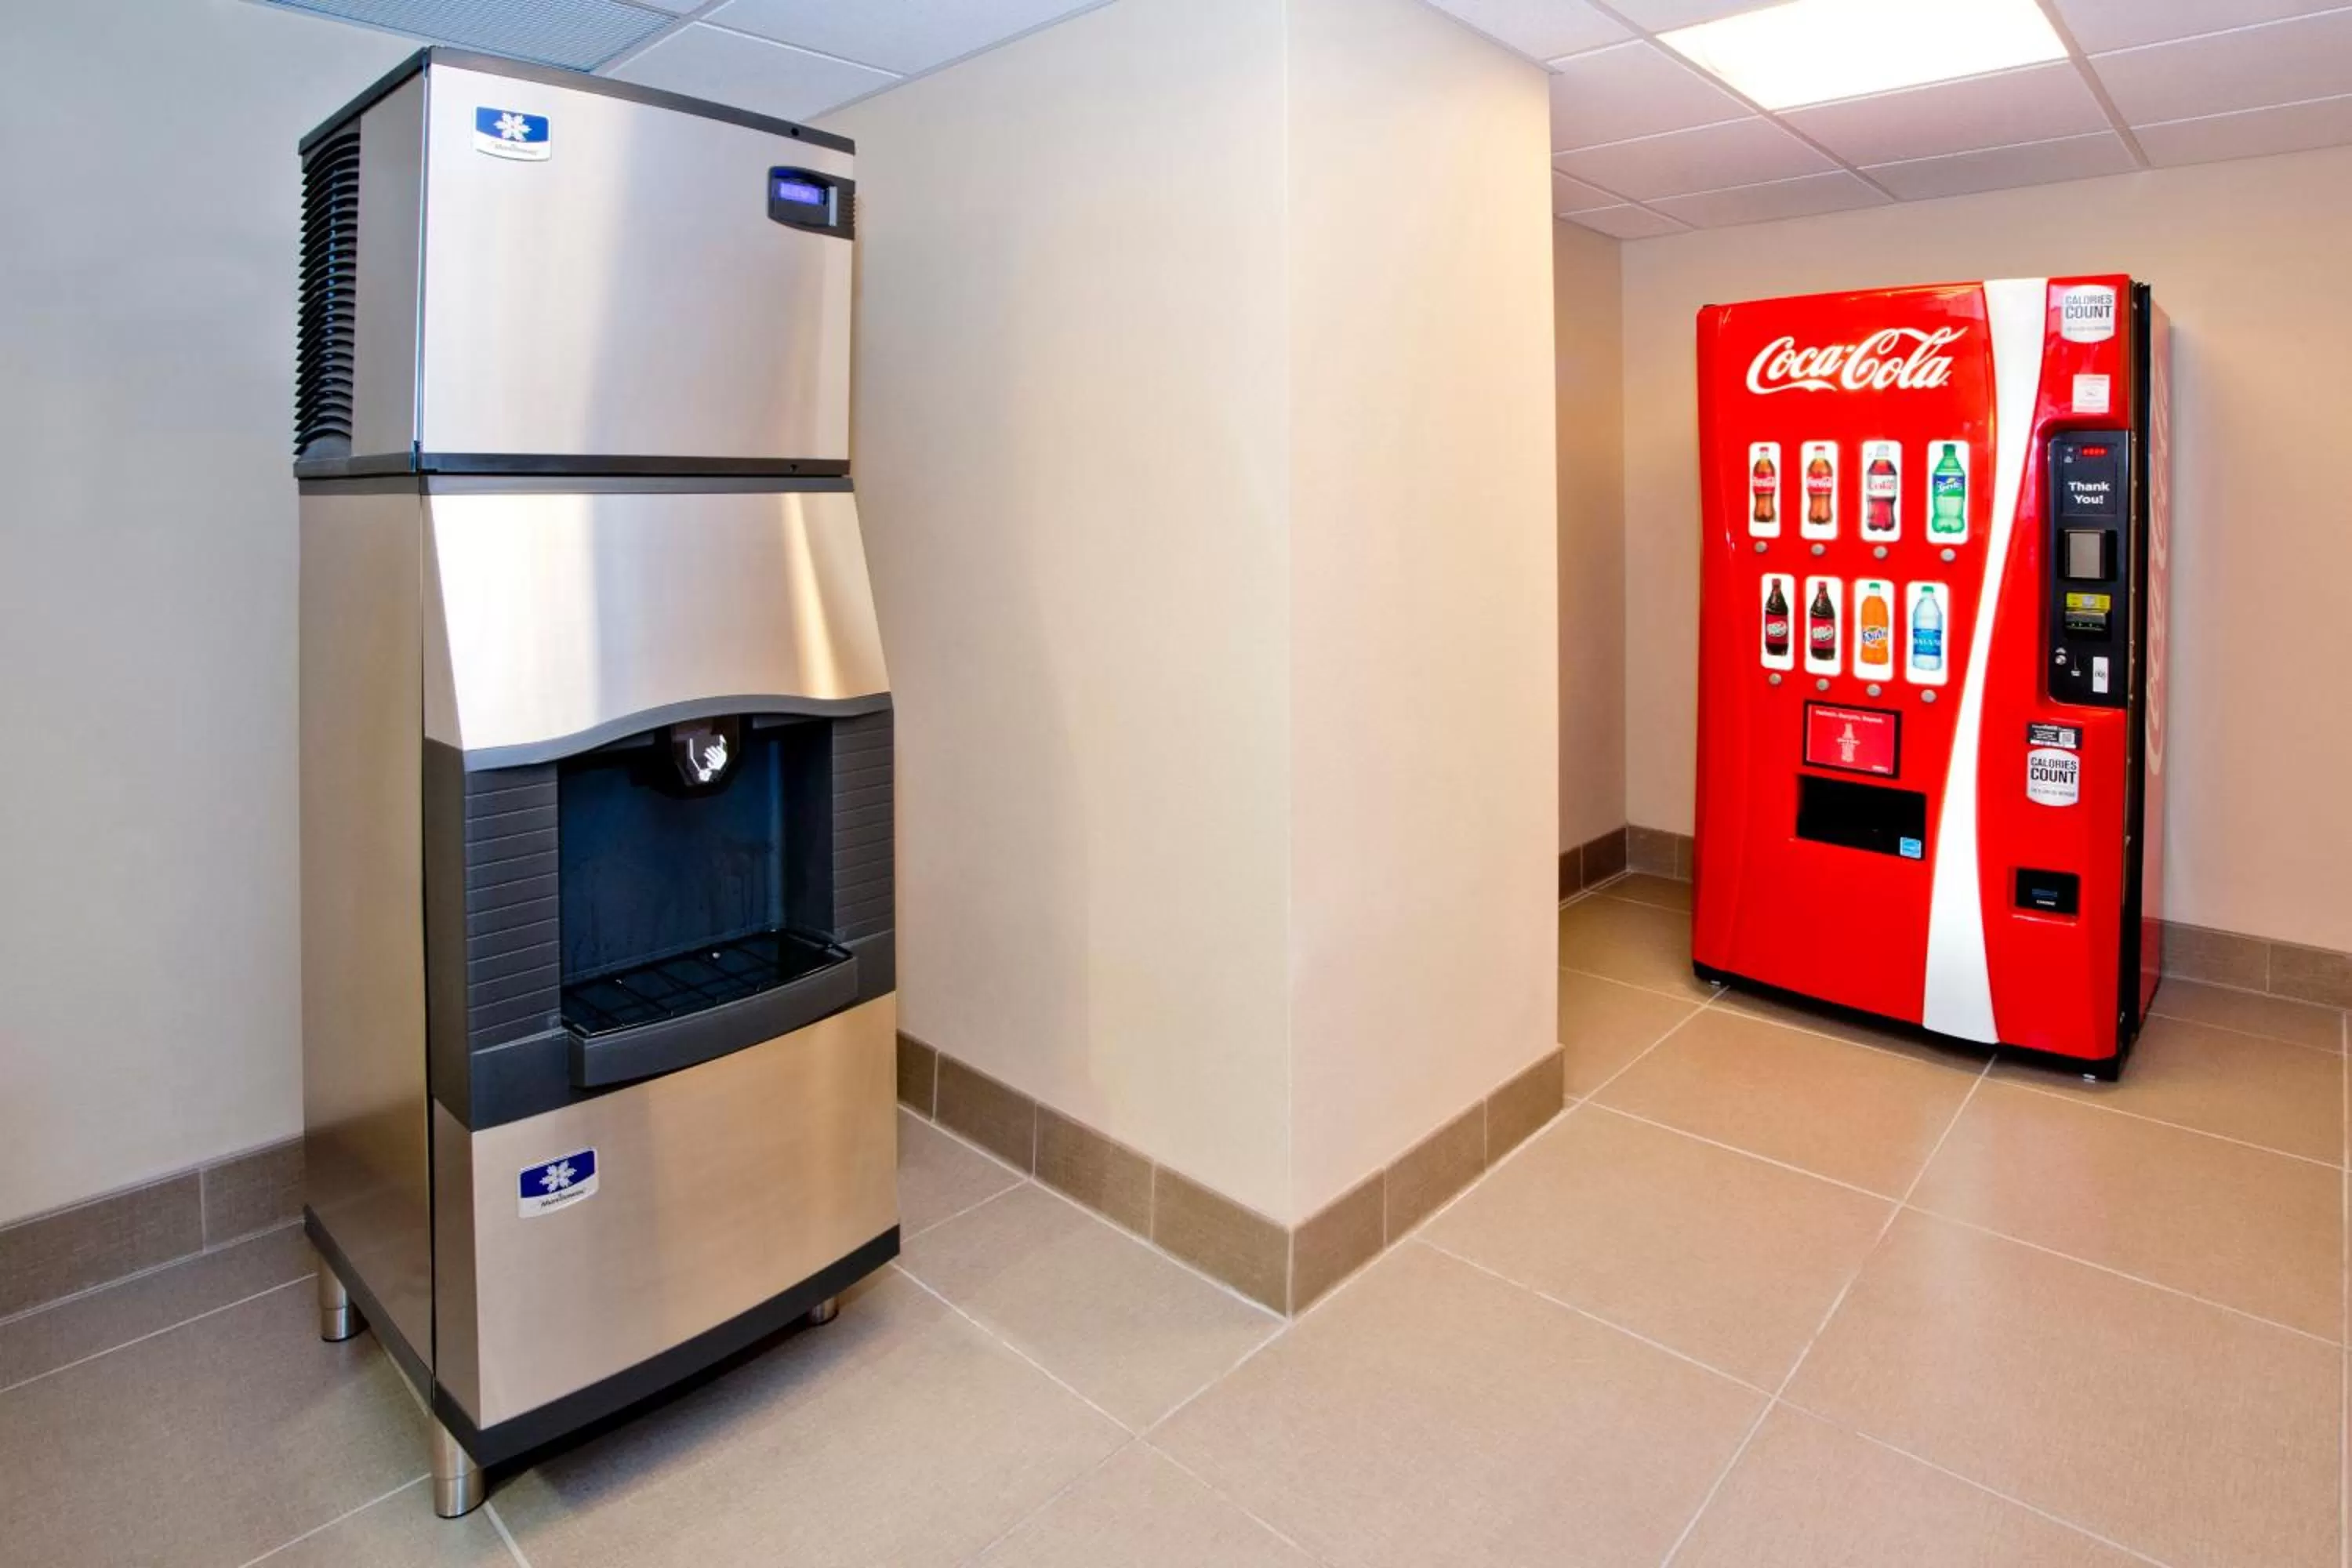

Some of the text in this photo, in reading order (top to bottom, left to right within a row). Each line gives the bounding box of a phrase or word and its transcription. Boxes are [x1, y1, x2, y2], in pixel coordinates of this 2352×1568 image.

[2065, 294, 2112, 305] CALORIES
[2066, 305, 2113, 320] COUNT
[1746, 326, 1969, 394] Coca-Cola
[2067, 481, 2111, 492] Thank
[2074, 495, 2104, 504] You!
[2030, 757, 2077, 770] CALORIES
[2031, 768, 2077, 783] COUNT
